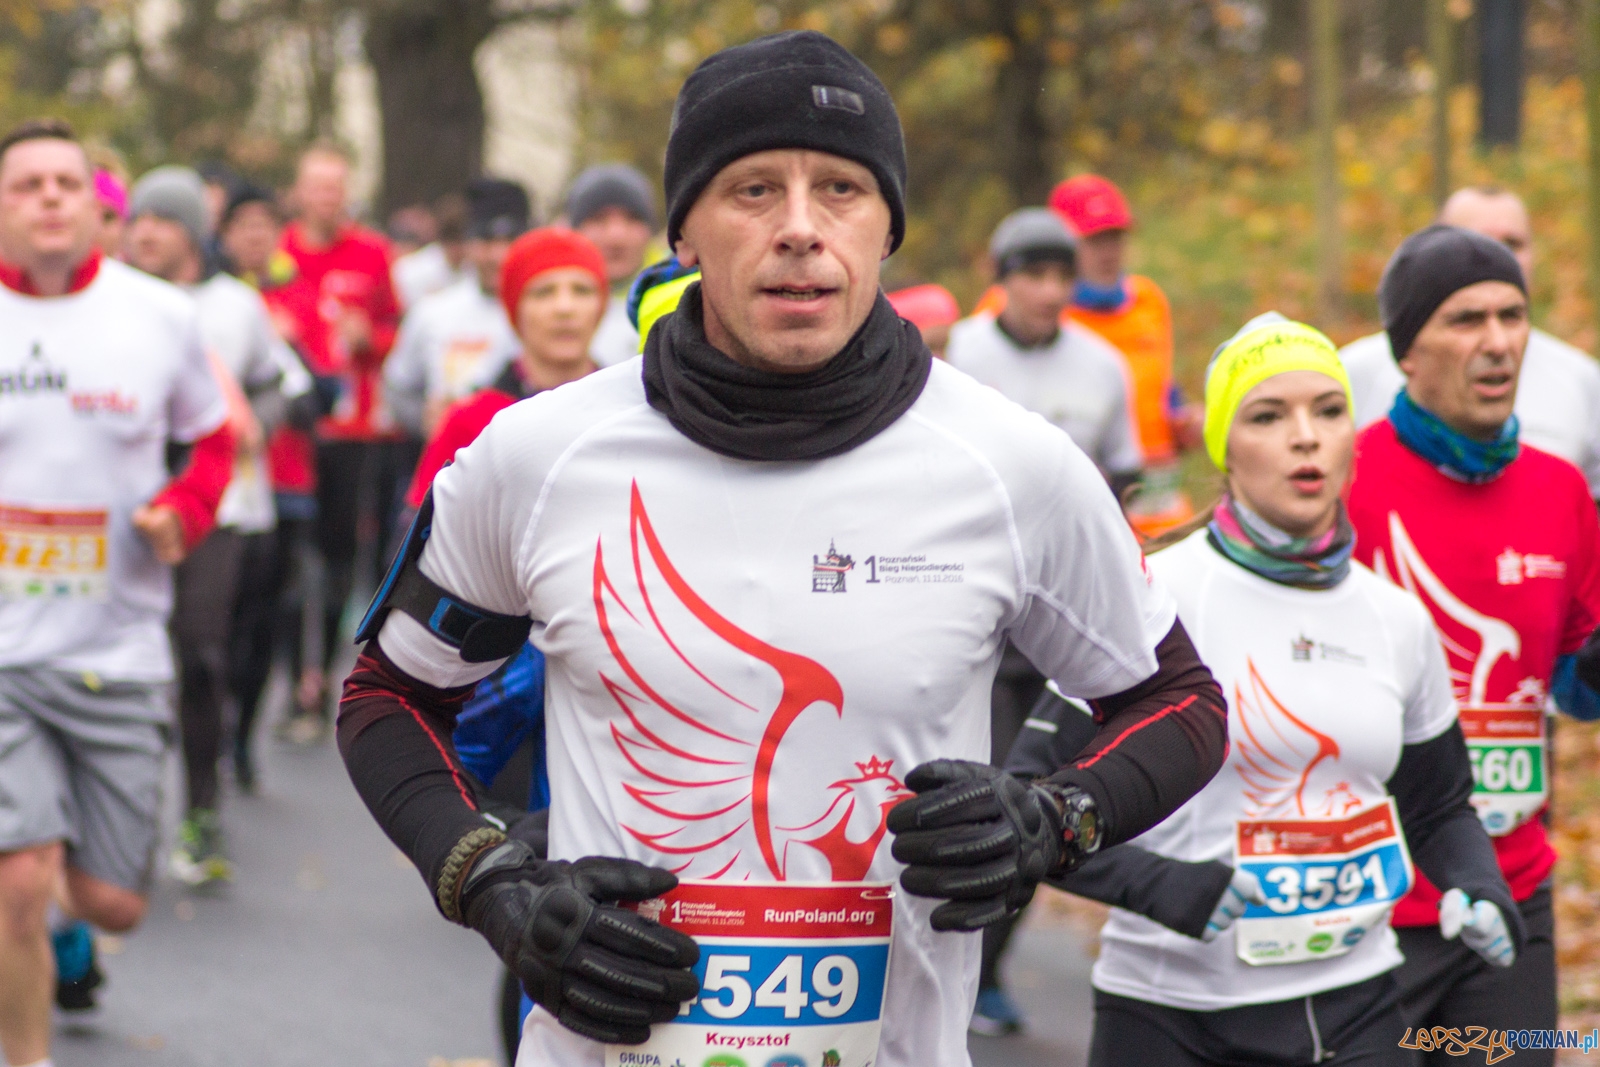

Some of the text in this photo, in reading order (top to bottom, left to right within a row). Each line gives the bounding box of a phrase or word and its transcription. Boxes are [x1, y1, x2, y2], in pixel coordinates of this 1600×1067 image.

[879, 554, 926, 564] Poznański
[864, 555, 881, 583] 1
[880, 563, 964, 573] Bieg Niepodległości
[1264, 853, 1389, 914] 3591
[671, 900, 682, 923] 1
[681, 902, 716, 911] Poznański
[696, 909, 745, 918] Niepodległości
[764, 907, 875, 925] RunPoland.org
[706, 1032, 791, 1049] Krzysztof
[619, 1052, 661, 1066] GRUPA
